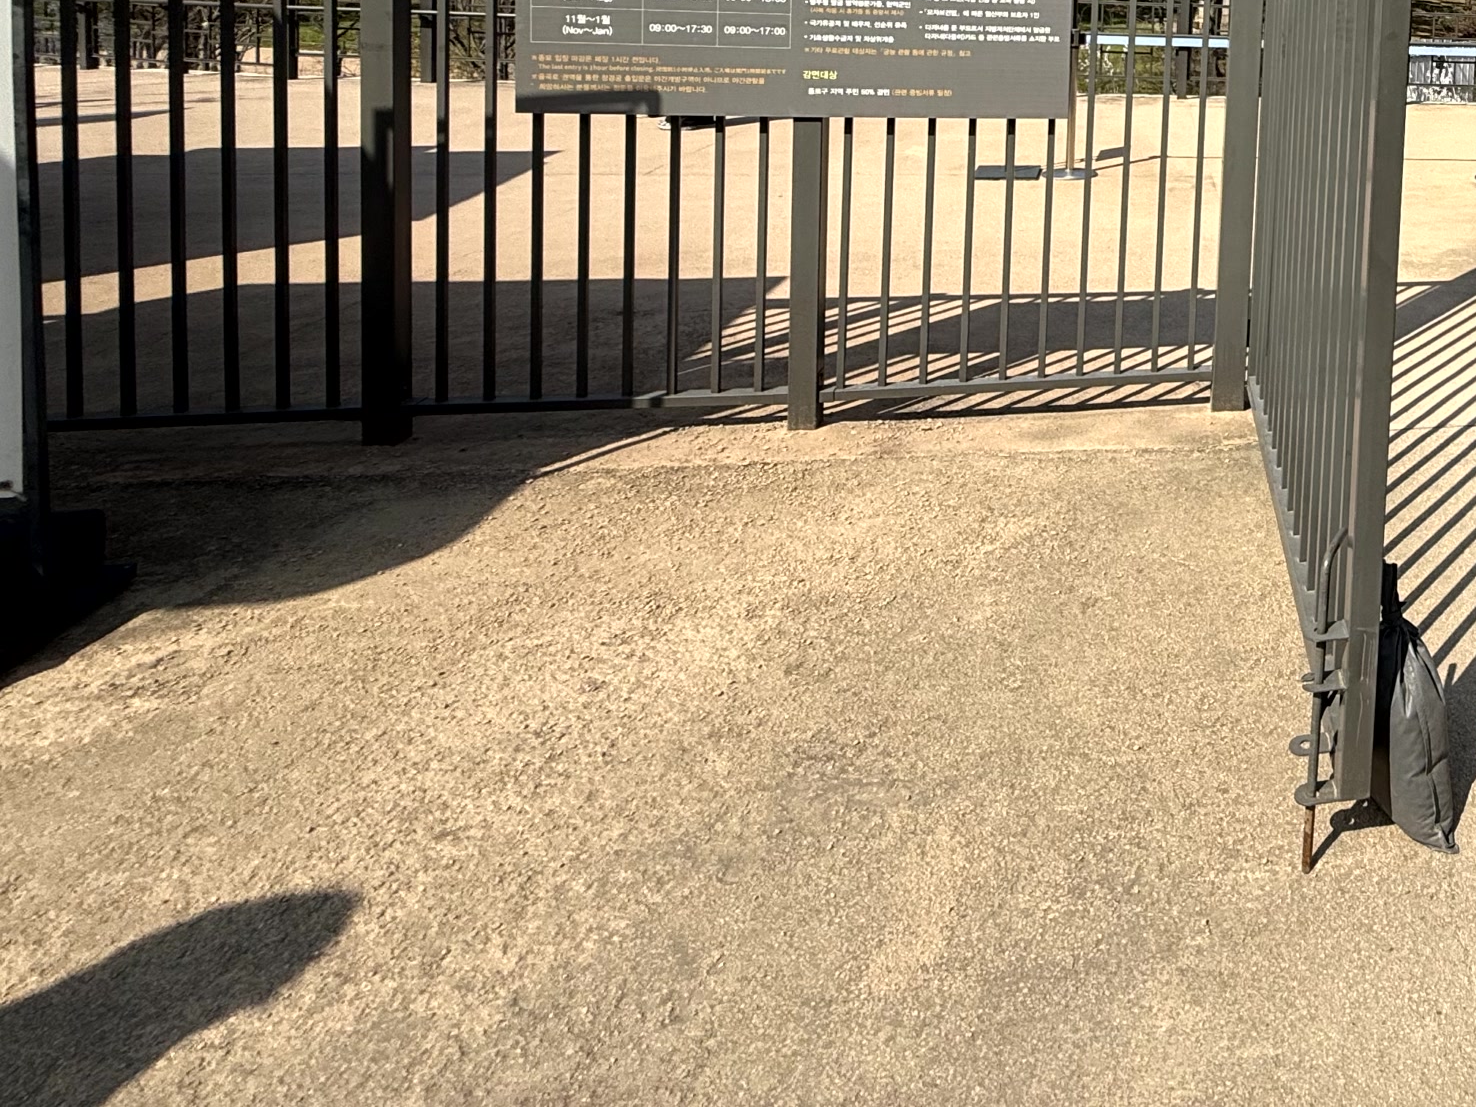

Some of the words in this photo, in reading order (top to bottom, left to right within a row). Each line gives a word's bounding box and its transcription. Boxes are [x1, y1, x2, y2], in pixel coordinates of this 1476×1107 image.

[564, 14, 611, 24] 11월~1월
[562, 25, 613, 36] (Nov~Jan)
[649, 24, 713, 34] 09:00~17:30
[724, 26, 786, 36] 09:00~17:00
[803, 70, 838, 80] 감면대상
